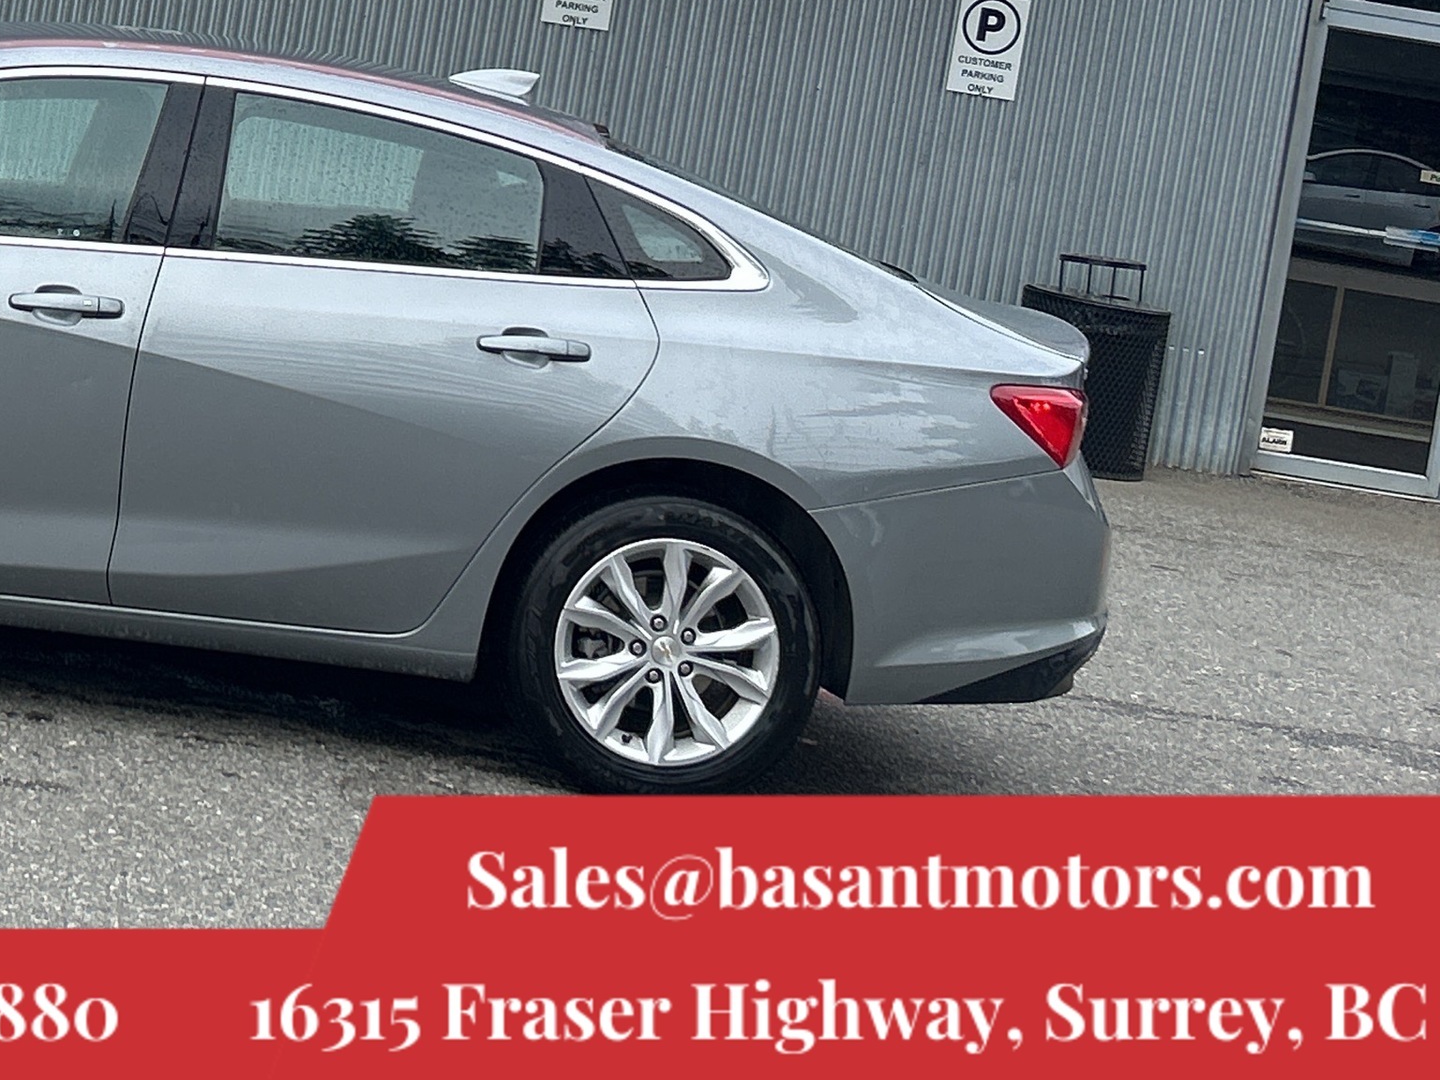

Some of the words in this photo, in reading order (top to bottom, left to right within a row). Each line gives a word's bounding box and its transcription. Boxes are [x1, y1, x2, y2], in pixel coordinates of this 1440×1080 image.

[555, 0, 598, 14] PARKING
[562, 14, 588, 25] ONLY
[976, 7, 1006, 42] P
[958, 55, 1012, 71] CUSTOMER
[961, 69, 1004, 83] PARKING
[967, 83, 994, 95] ONLY
